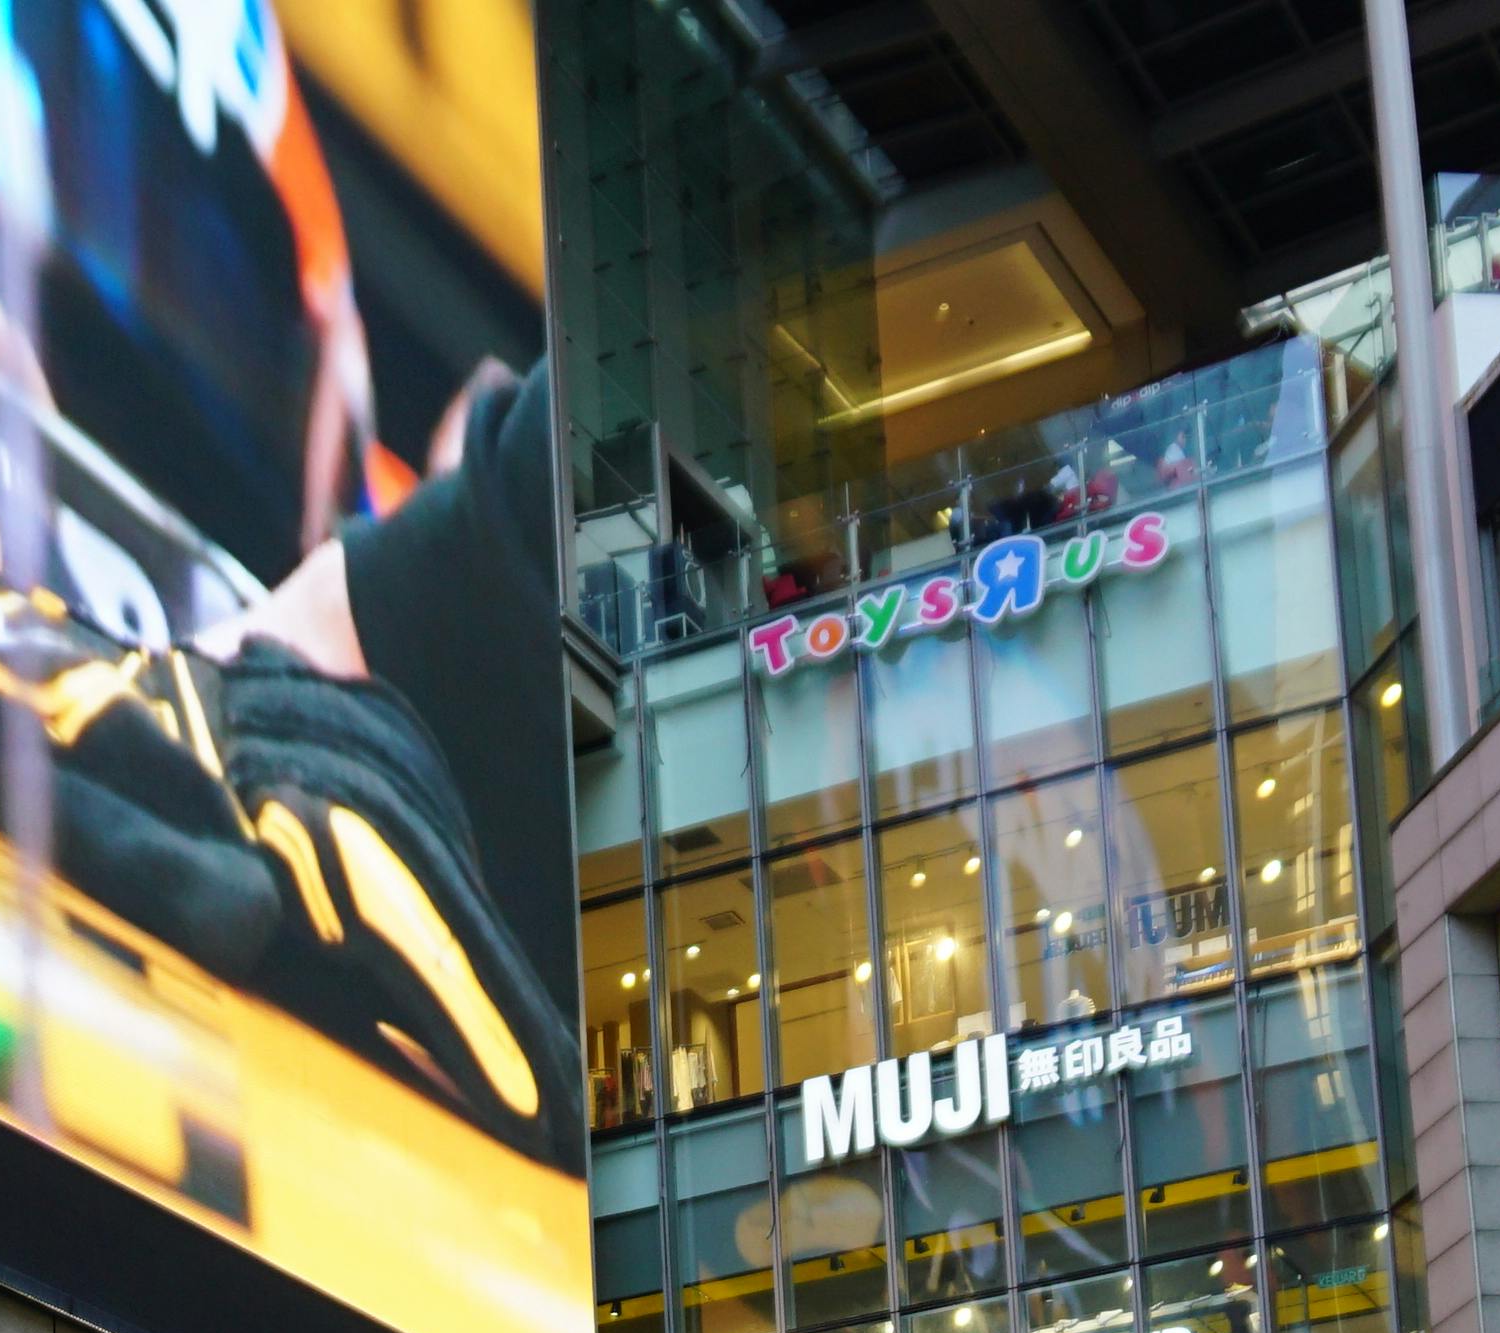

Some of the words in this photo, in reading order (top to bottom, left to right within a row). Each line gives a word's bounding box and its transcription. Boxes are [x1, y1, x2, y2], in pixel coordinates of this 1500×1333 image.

[802, 1033, 1011, 1165] MUJI
[1017, 1015, 1193, 1090] 無印良品
